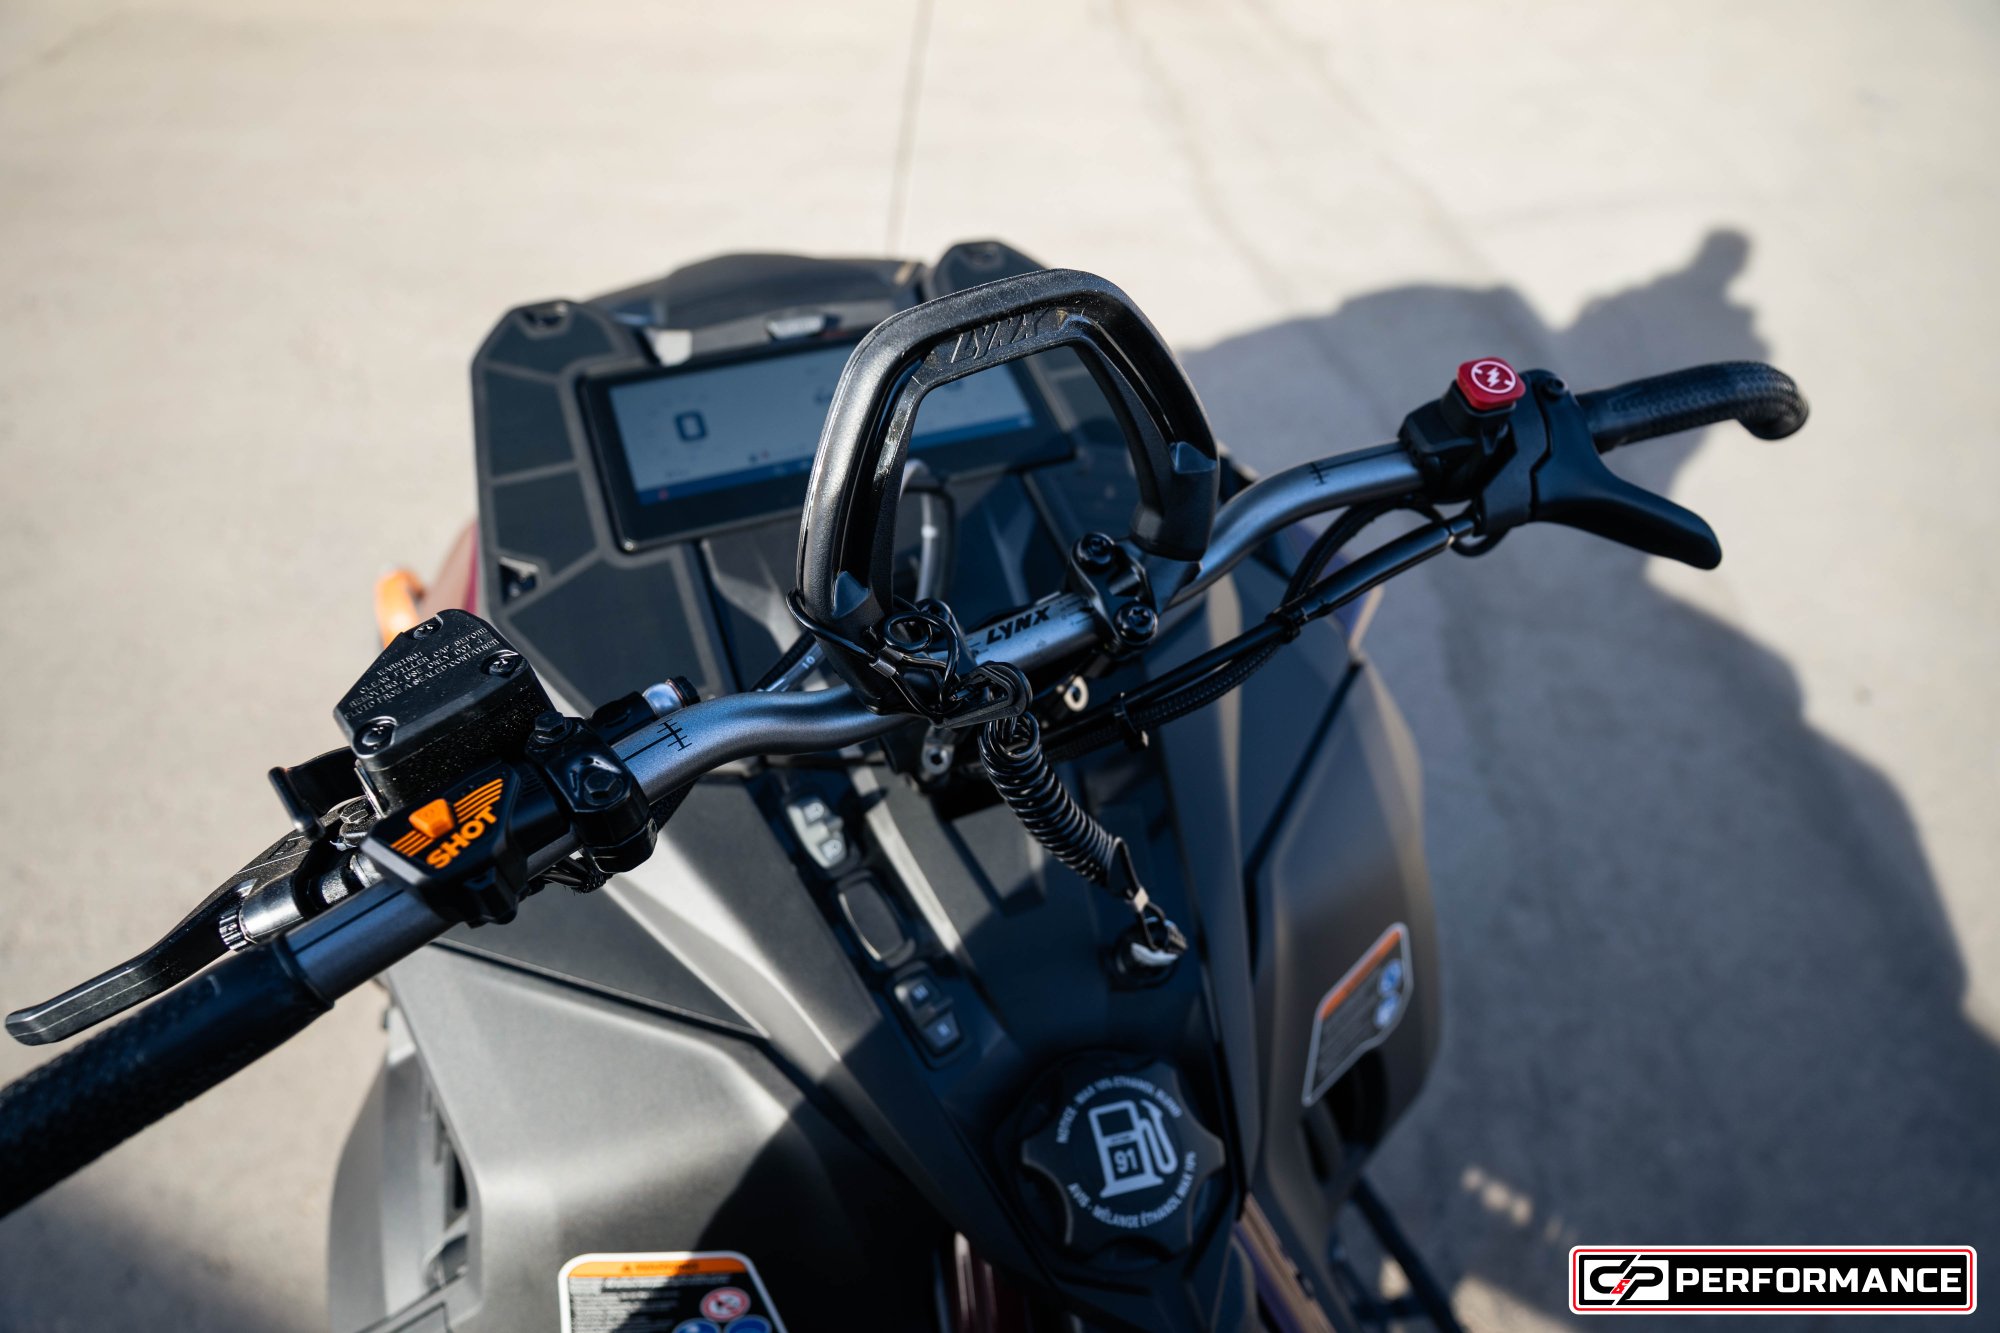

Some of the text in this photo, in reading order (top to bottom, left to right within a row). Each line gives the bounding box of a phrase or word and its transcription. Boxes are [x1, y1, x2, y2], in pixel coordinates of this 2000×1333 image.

[986, 605, 1050, 646] LYNX
[360, 675, 391, 694] CLEAN
[394, 656, 430, 677] FILLER
[433, 645, 450, 658] CAP
[427, 653, 451, 669] ONLY
[454, 643, 472, 656] DOT
[426, 805, 498, 870] SHOT
[1113, 1148, 1139, 1174] 91
